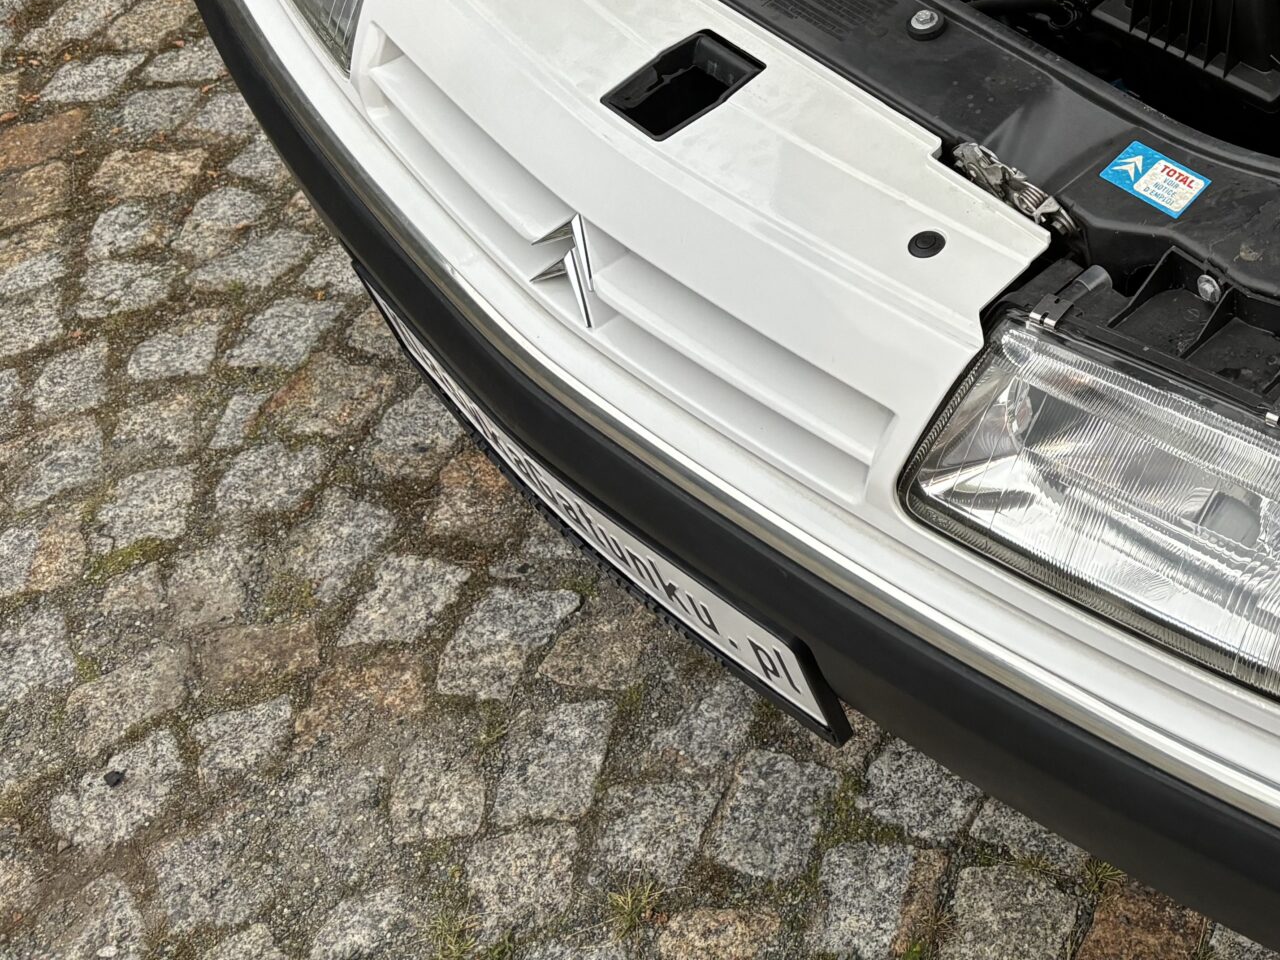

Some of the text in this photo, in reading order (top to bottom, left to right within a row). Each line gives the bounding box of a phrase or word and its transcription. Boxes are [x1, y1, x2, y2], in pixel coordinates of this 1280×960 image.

[1160, 164, 1195, 189] TOTAL
[1163, 177, 1180, 189] VOIR
[1153, 182, 1178, 197] NOTICE
